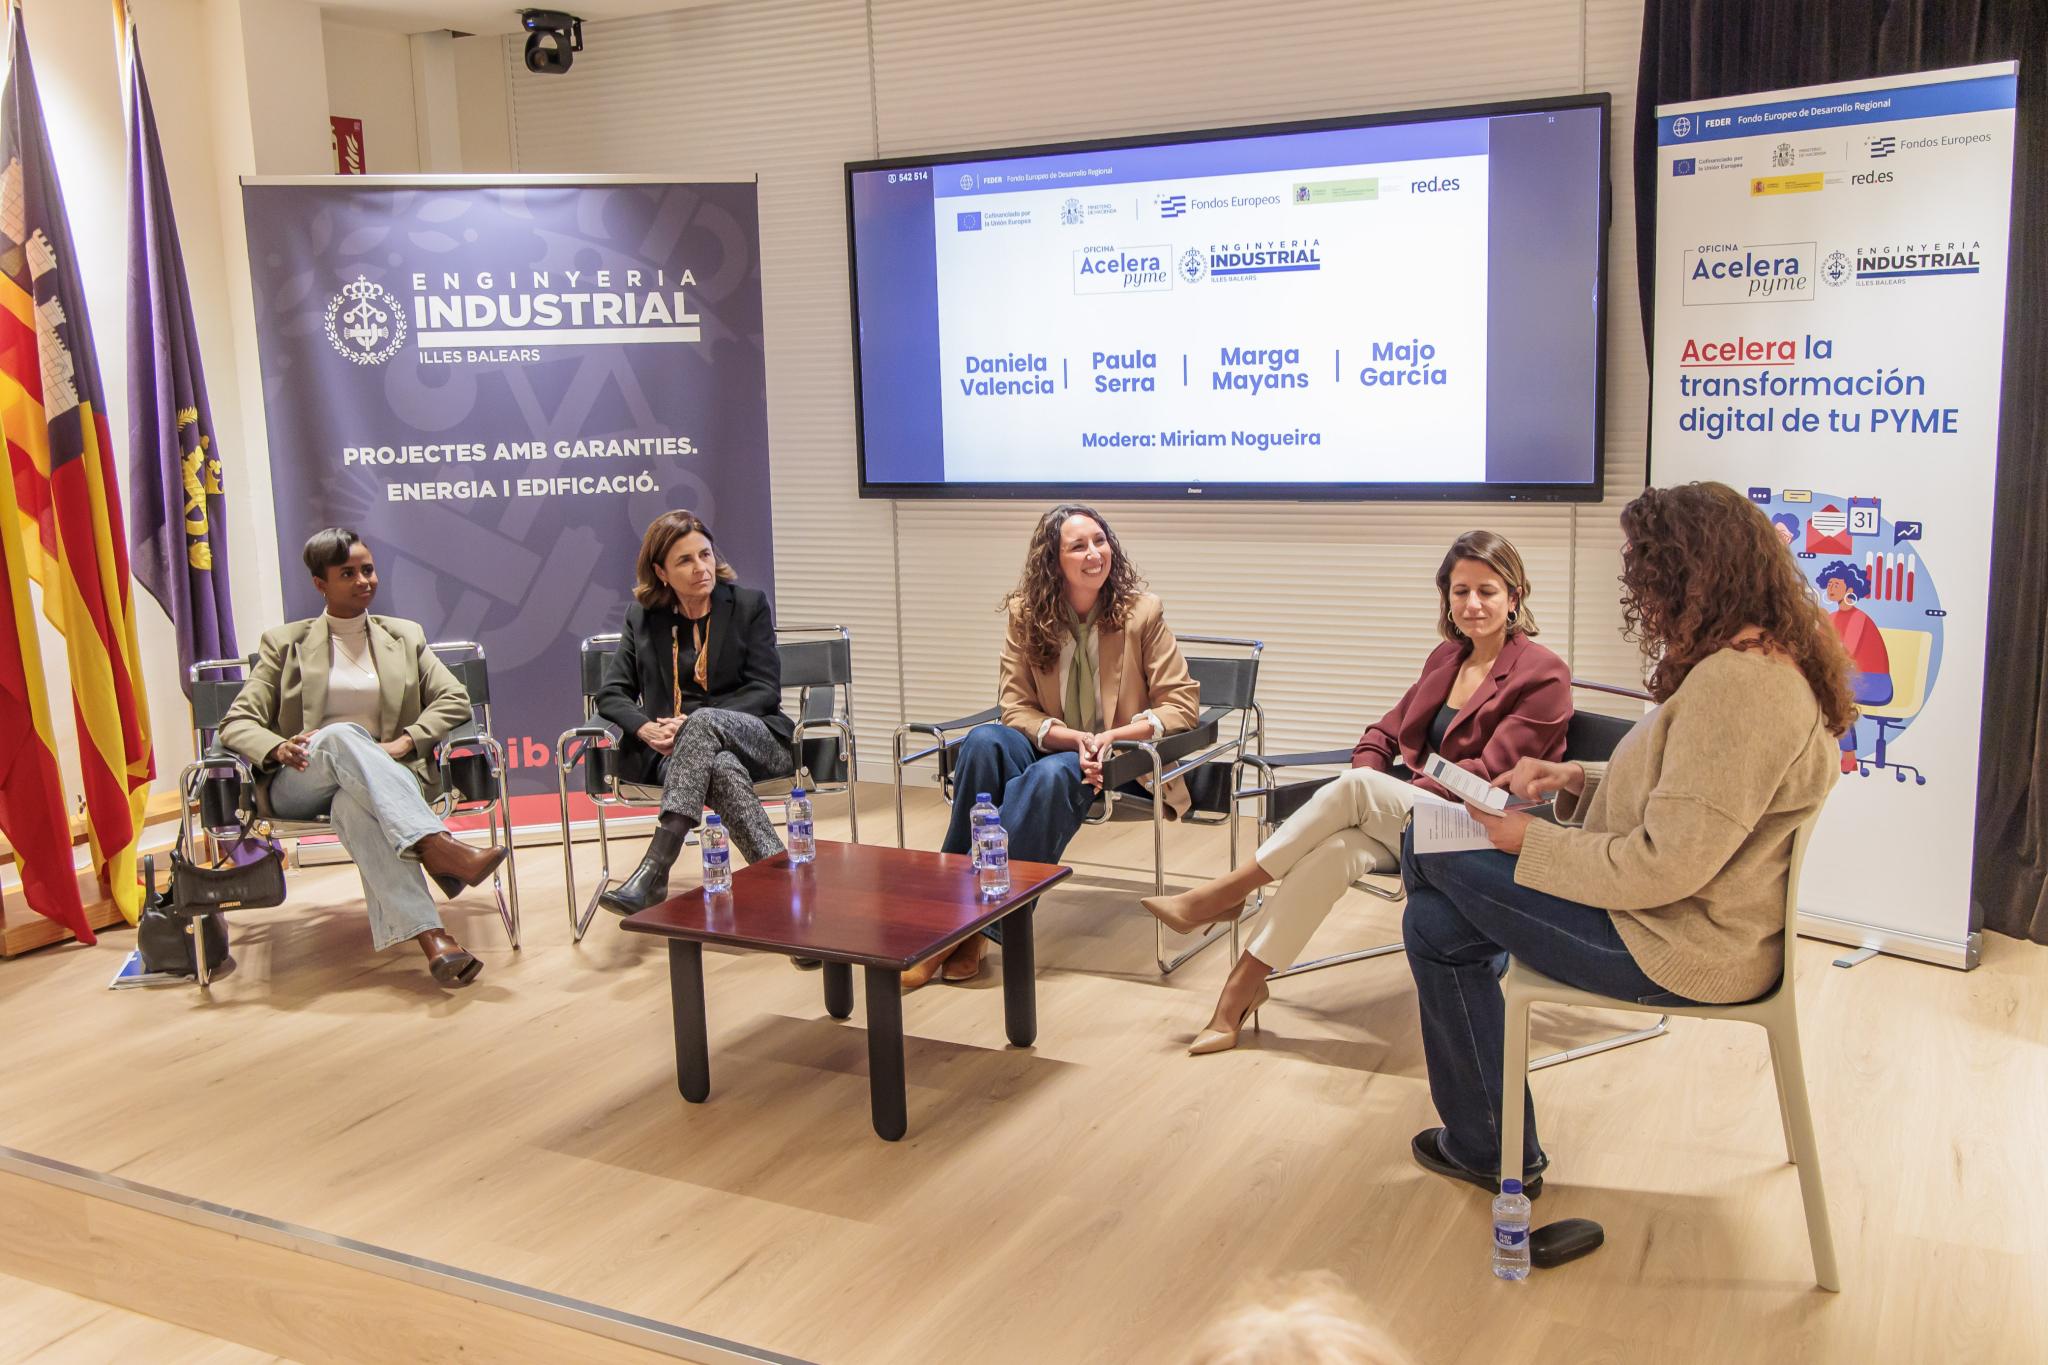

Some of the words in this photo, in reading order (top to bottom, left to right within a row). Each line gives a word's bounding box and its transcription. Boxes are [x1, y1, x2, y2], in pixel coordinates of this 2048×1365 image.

[1705, 117, 1731, 128] FEDER
[1738, 114, 1762, 125] Fondo
[1764, 110, 1797, 124] Europeo
[1799, 108, 1808, 117] de
[1811, 103, 1852, 116] Desarrollo
[1854, 98, 1891, 113] Regional
[1900, 137, 1939, 151] Fondos
[1941, 132, 1992, 149] Europeos
[1698, 157, 1733, 165] Cofinanciado
[898, 172, 913, 182] 542
[913, 171, 928, 181] 514
[983, 176, 1003, 185] FEDER
[1006, 174, 1024, 183] Fondo
[1025, 172, 1048, 183] Europeo
[1049, 171, 1057, 179] de
[1057, 169, 1086, 178] Desarrollo
[1087, 167, 1113, 178] Regional
[1411, 176, 1460, 194] red.es
[1851, 169, 1894, 186] red.es
[1191, 197, 1229, 210] Fondos
[1231, 193, 1281, 210] Europeos
[991, 219, 1006, 227] Unión
[1008, 218, 1031, 227] Europea
[1021, 211, 1031, 219] por
[1083, 245, 1115, 253] OFICINA
[1210, 239, 1320, 252] ENGINYERIA
[1698, 244, 1738, 254] OFICINA
[1857, 241, 1980, 255] ENGINYERIA
[1080, 252, 1161, 275] Acelera
[1210, 249, 1320, 268] INDUSTRIAL
[1691, 252, 1799, 280] Acelera
[1856, 252, 1980, 271] INDUSTRIAL
[413, 269, 697, 291] ENGINYERIA
[1123, 270, 1167, 288] pyme
[1748, 277, 1807, 297] pyme
[1875, 278, 1906, 286] BALEARS
[415, 291, 700, 329] INDUSTRIAL
[419, 351, 462, 364] ILLES
[467, 349, 541, 363] BALEARS
[1092, 347, 1157, 370] Paula
[1220, 344, 1300, 371] Marga
[1372, 340, 1435, 366] Majo
[1681, 336, 1796, 363] Acelera
[1805, 334, 1832, 360] la
[965, 352, 1048, 374] Daniela
[1094, 372, 1156, 393] Serra
[1212, 367, 1309, 395] Mayans
[1360, 362, 1448, 387] García
[1680, 367, 1925, 397] transformación
[960, 374, 1055, 396] Valencia
[1679, 406, 1774, 440] digital
[1782, 406, 1819, 433] de
[1829, 408, 1861, 433] tu
[1870, 408, 1958, 434] PYME
[1082, 430, 1156, 448] Modera:
[1160, 429, 1227, 447] Miriam
[1231, 428, 1321, 451] Nogueira
[343, 443, 487, 466] PROJECTES
[493, 442, 548, 462] AMB
[554, 437, 698, 459] GARANTIES.
[387, 481, 497, 502] ENERGIA
[504, 480, 510, 498] I
[517, 471, 660, 498] EDIFICACIÓ.
[1854, 511, 1873, 531] 31
